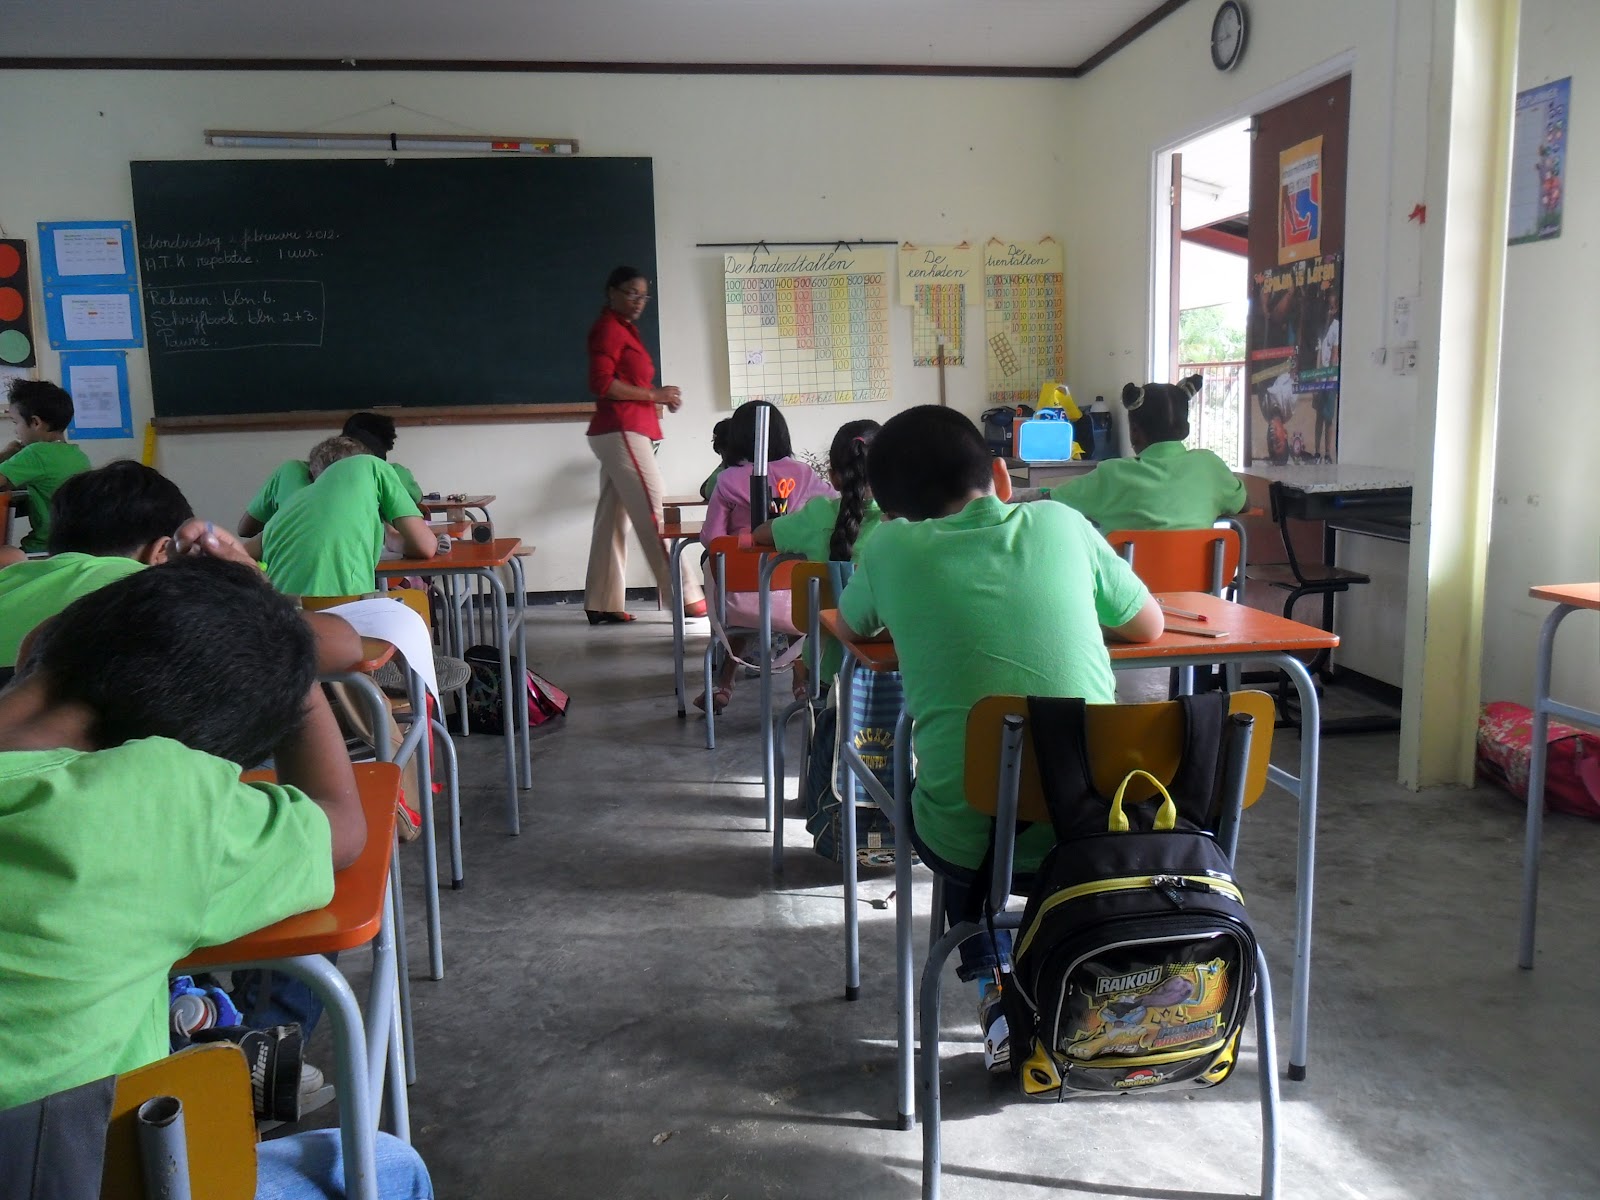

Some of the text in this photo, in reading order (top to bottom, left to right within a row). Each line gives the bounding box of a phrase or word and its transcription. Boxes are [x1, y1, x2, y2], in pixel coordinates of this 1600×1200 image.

[1008, 244, 1026, 256] De
[725, 255, 746, 274] De
[923, 250, 947, 265] De
[726, 275, 881, 290] 100 200 300 400 500 600 700 800 900
[726, 287, 880, 302] 100 100 100 100 100 100 100 100 100
[743, 305, 758, 314] 100
[761, 304, 774, 313] 100
[796, 303, 810, 312] 100
[813, 302, 826, 312] 100
[830, 301, 846, 310] 100
[849, 300, 864, 309] 100
[867, 300, 880, 309] 100
[762, 311, 881, 326] 100 100 100 100 100 100 100
[780, 322, 882, 336] 100 100 100 100 100 100
[797, 334, 883, 348] 100 100 100 100 100
[816, 346, 884, 359] 100 100 100 100
[834, 357, 884, 370] 100 100 100
[853, 369, 885, 380] 100 100
[1100, 971, 1159, 993] RAIKOU
